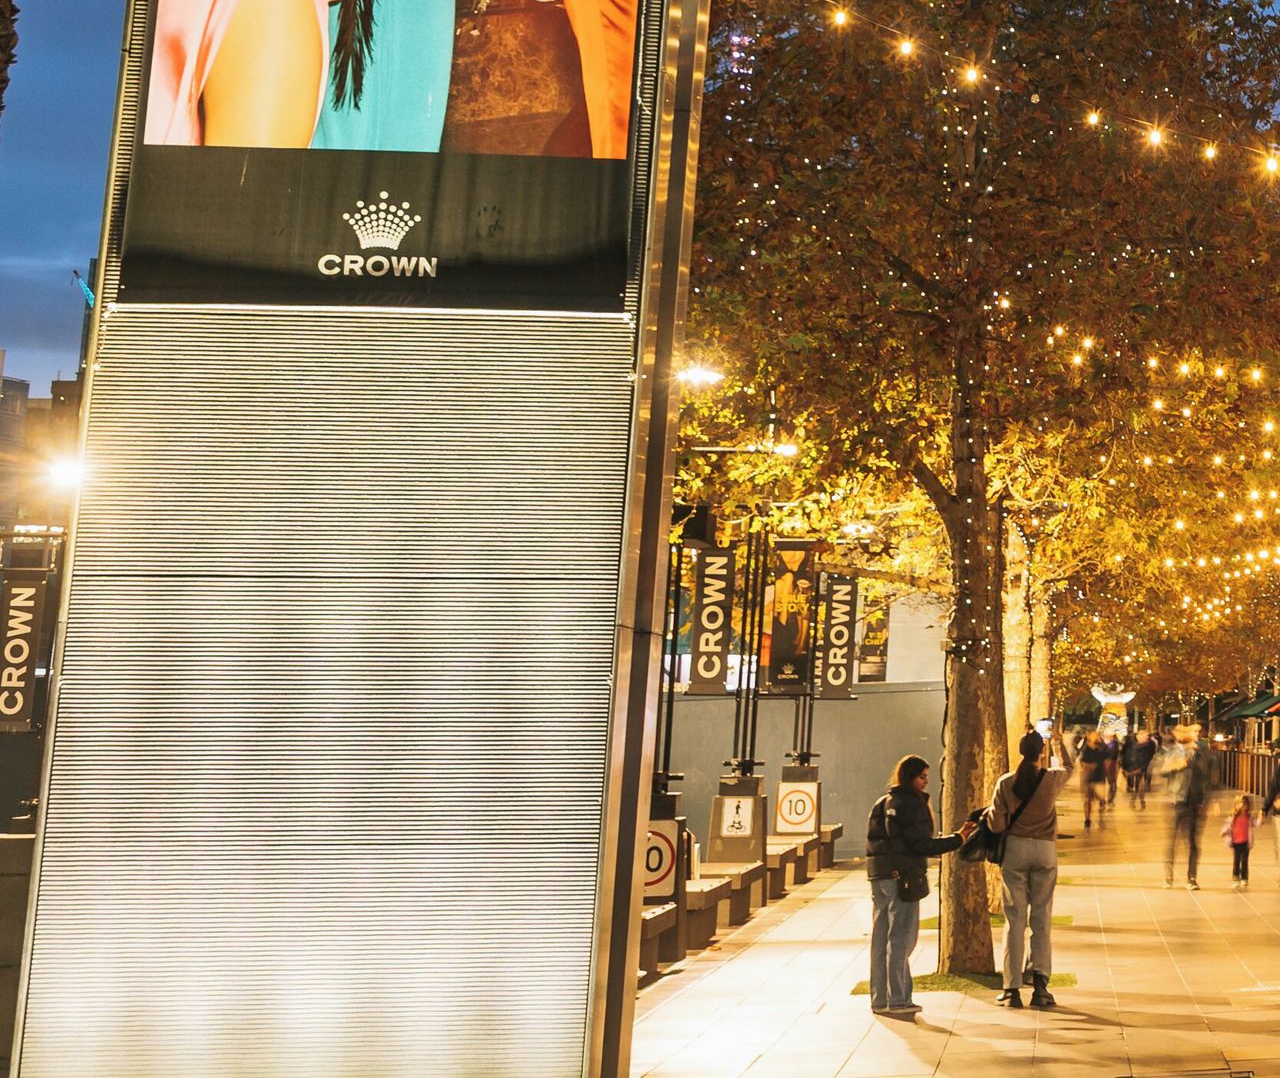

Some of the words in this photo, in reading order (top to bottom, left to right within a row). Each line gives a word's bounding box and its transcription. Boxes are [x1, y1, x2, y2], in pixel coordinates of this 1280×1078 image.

[317, 254, 438, 277] CROWN
[697, 556, 728, 679] CROWN
[827, 584, 852, 686] CROWN
[0, 587, 36, 715] CROWN
[788, 799, 806, 816] 10
[645, 846, 663, 873] 0
